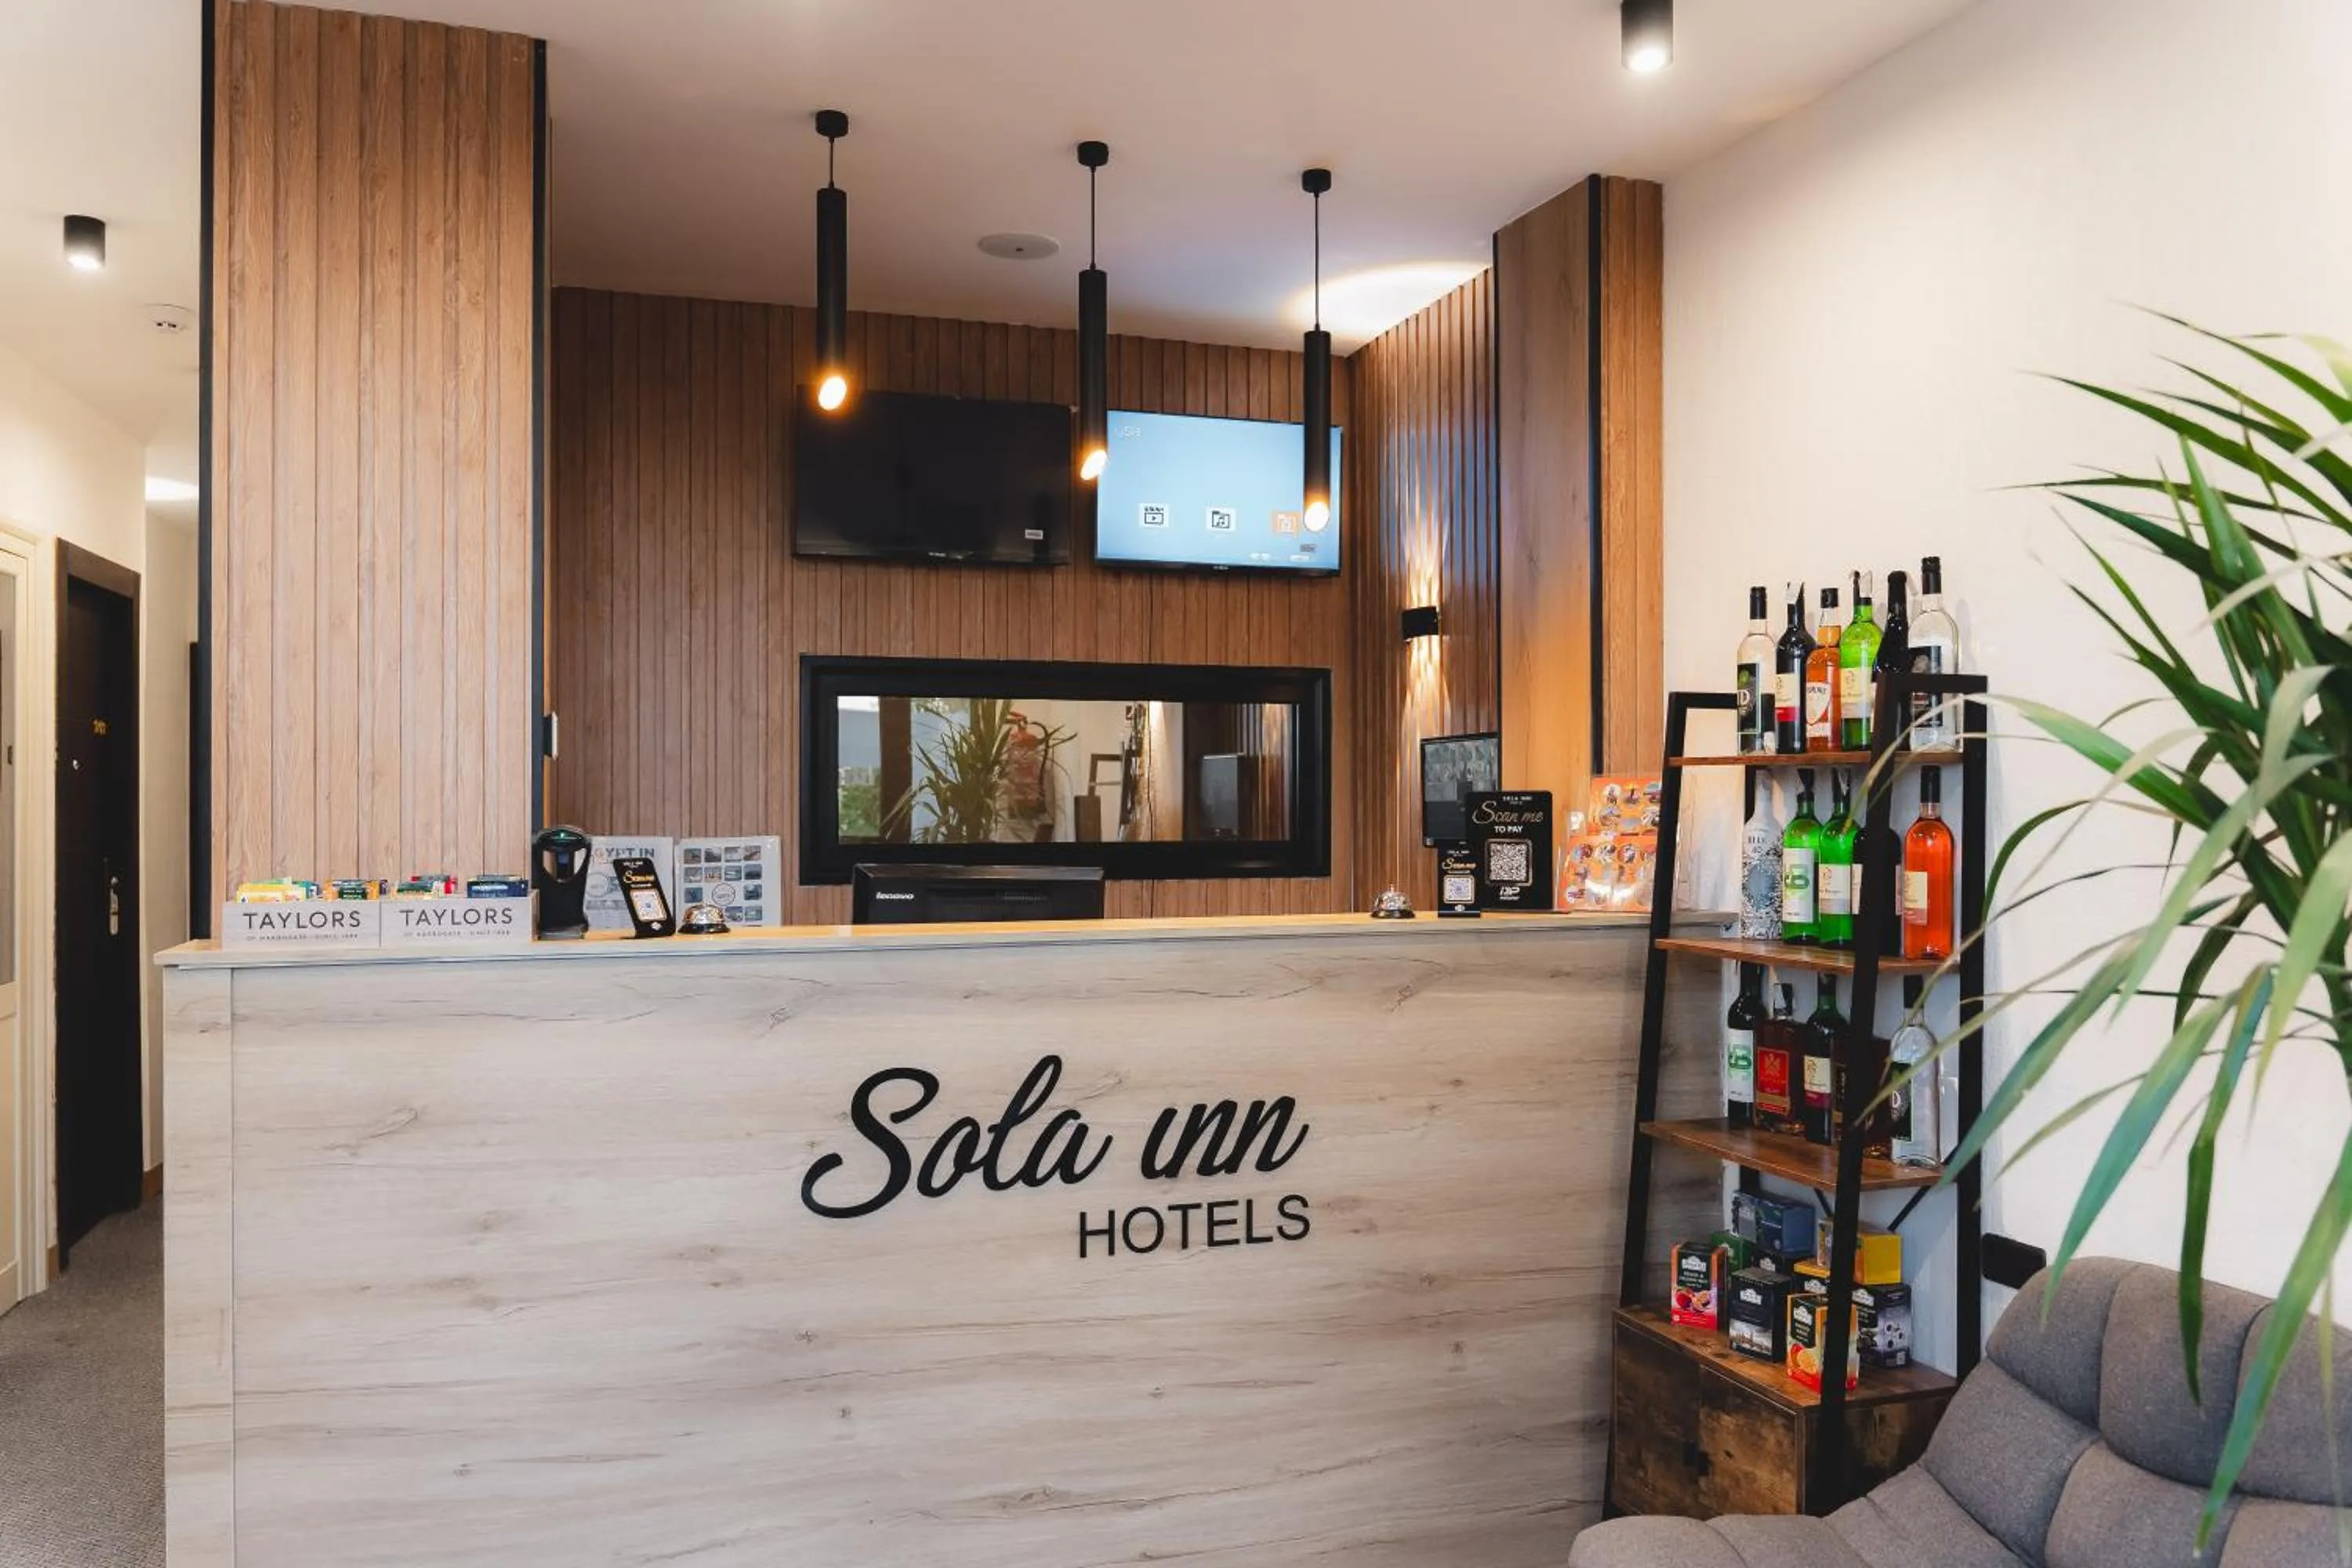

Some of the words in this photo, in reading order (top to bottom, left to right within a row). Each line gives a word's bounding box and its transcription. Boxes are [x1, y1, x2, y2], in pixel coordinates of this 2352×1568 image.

[1472, 800, 1519, 824] Scan
[1521, 811, 1544, 823] me
[639, 847, 655, 858] IN
[242, 910, 361, 930] TAYLORS
[399, 907, 513, 927] TAYLORS
[800, 1054, 1113, 1219] Sola
[1140, 1095, 1310, 1179] inn
[1079, 1194, 1311, 1258] HOTELS
